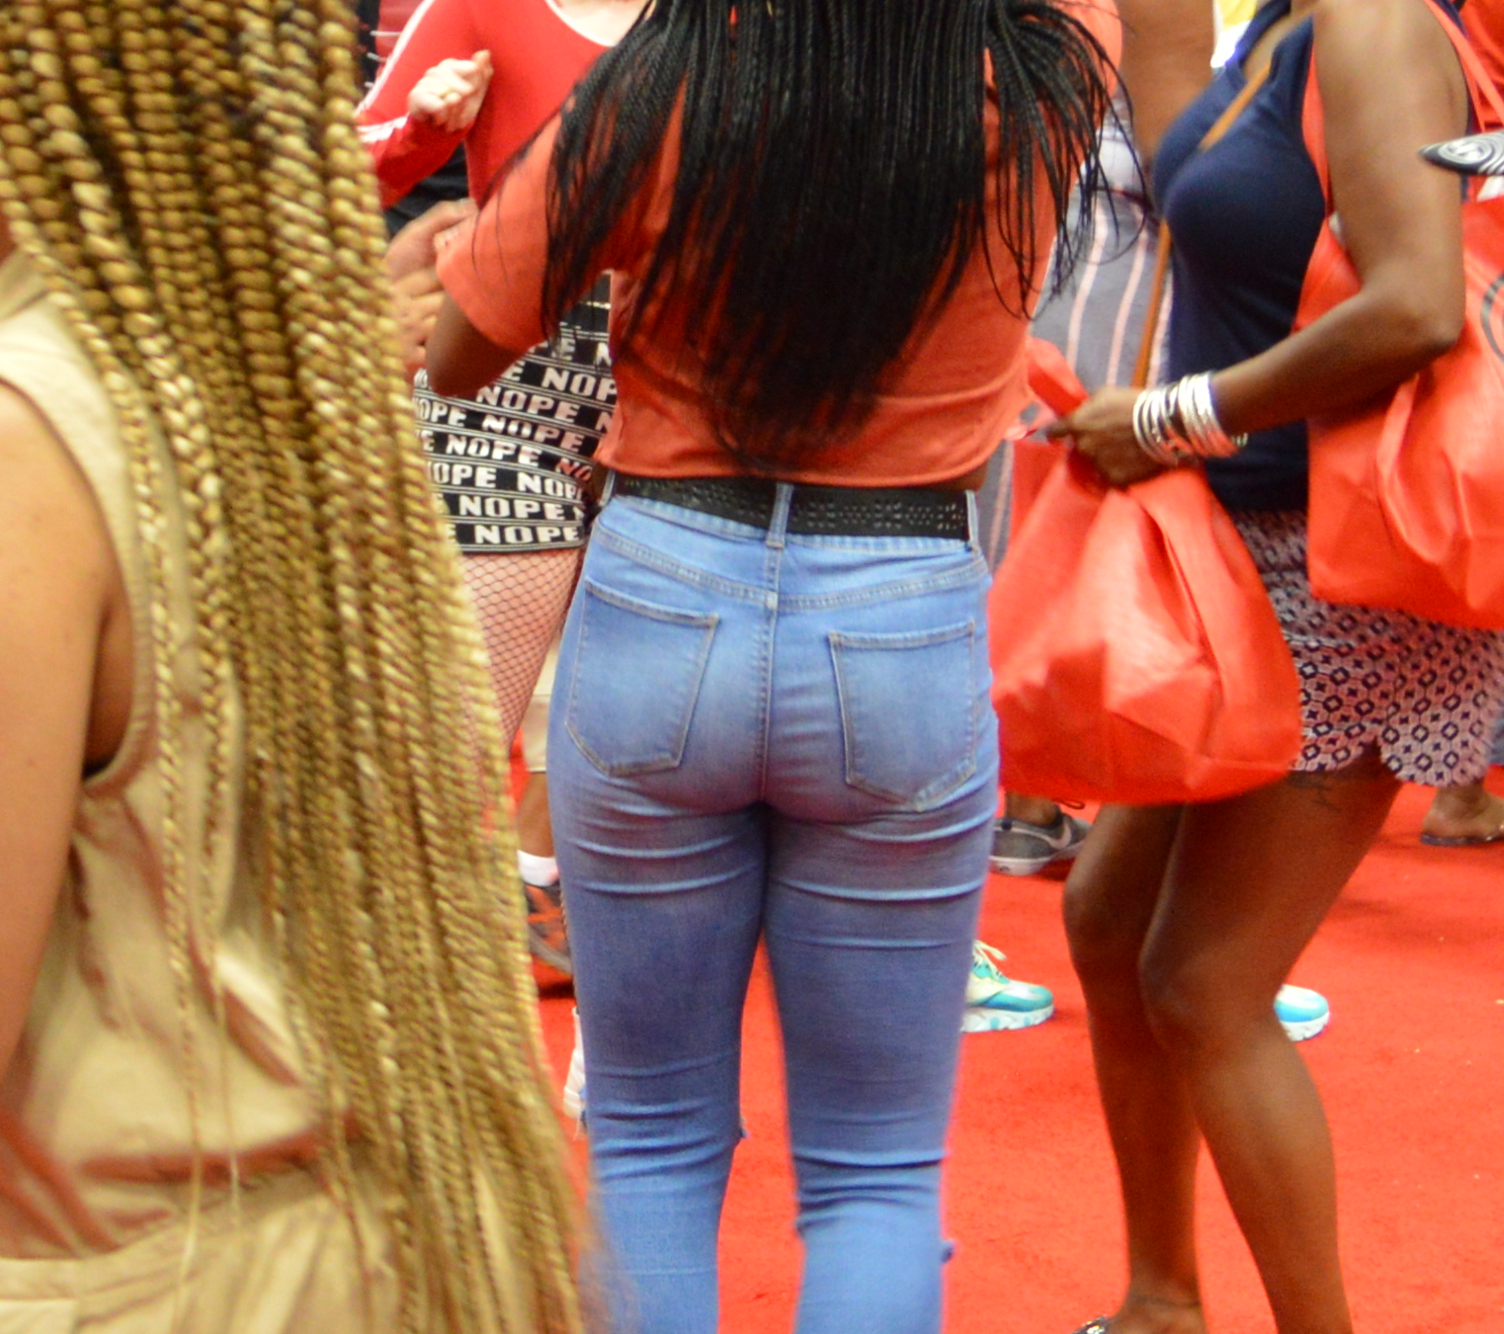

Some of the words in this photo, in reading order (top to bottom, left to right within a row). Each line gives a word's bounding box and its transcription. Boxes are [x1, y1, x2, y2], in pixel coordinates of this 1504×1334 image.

[476, 385, 580, 424] NOPE
[446, 433, 543, 468] NOPE
[482, 414, 585, 454] NOPE
[459, 495, 566, 521] NOPE
[475, 525, 580, 545] NOPE
